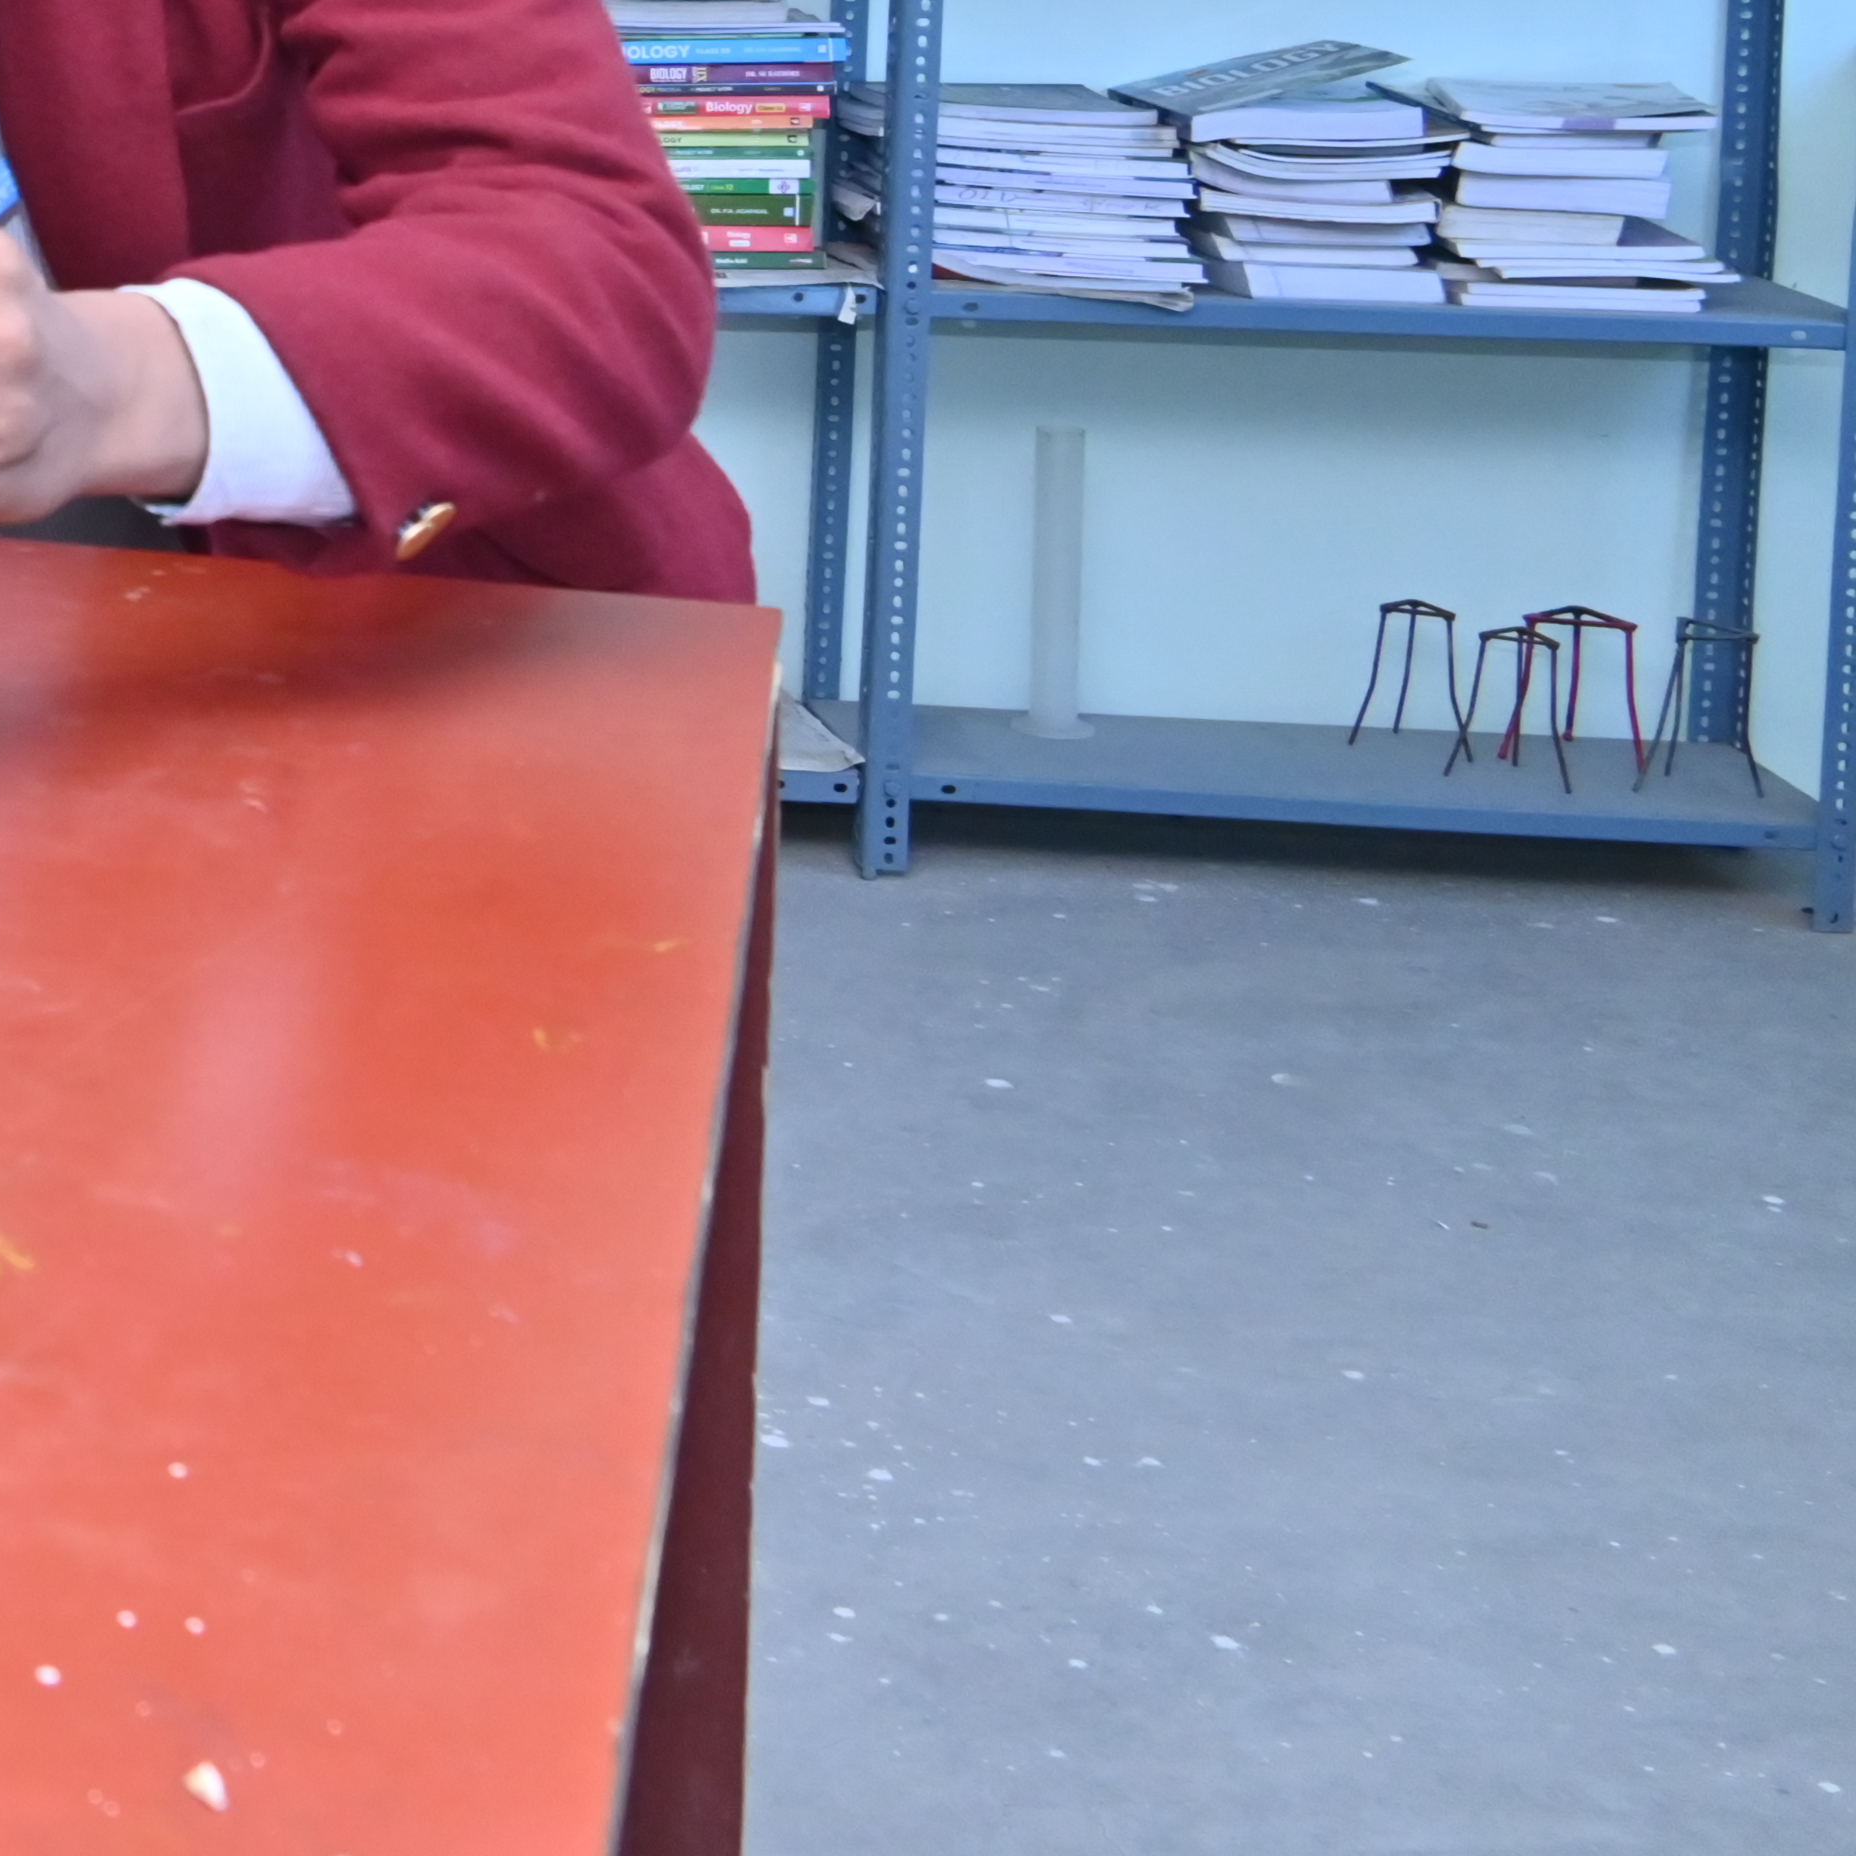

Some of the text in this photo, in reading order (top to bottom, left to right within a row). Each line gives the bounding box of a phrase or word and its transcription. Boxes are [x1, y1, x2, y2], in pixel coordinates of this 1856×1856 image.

[650, 67, 687, 80] BIOLOGY
[1152, 44, 1341, 96] BIOLOGY
[706, 101, 753, 114] Biology
